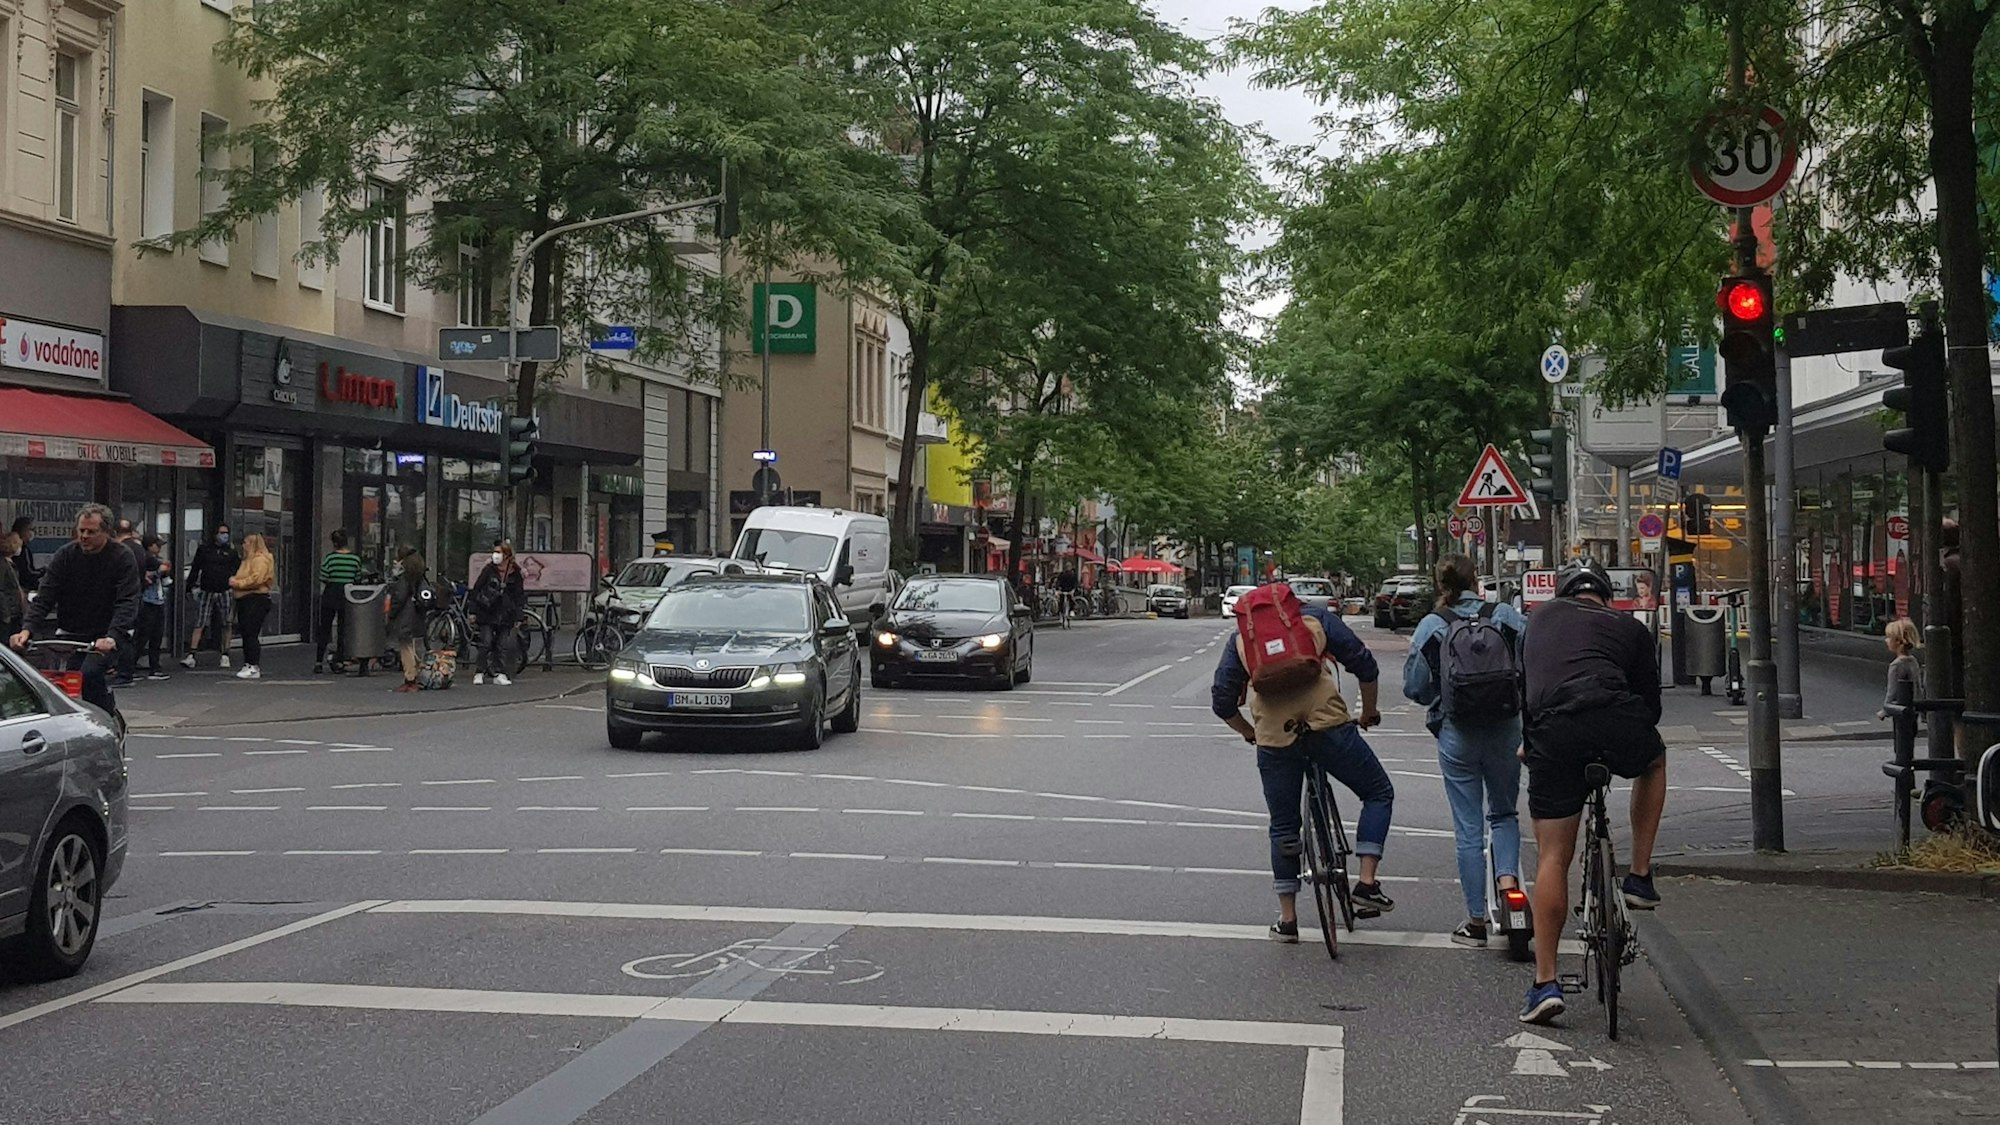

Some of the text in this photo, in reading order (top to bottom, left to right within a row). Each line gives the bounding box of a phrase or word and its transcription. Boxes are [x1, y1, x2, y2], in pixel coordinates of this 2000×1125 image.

[1709, 127, 1773, 177] 30
[769, 294, 803, 329] D
[34, 336, 99, 371] vodafone
[451, 394, 503, 435] Deutsch
[106, 444, 138, 463] MOBILE
[1662, 451, 1676, 475] P
[1450, 520, 1466, 532] STP
[1527, 574, 1556, 588] NEU
[704, 694, 730, 706] 1039
